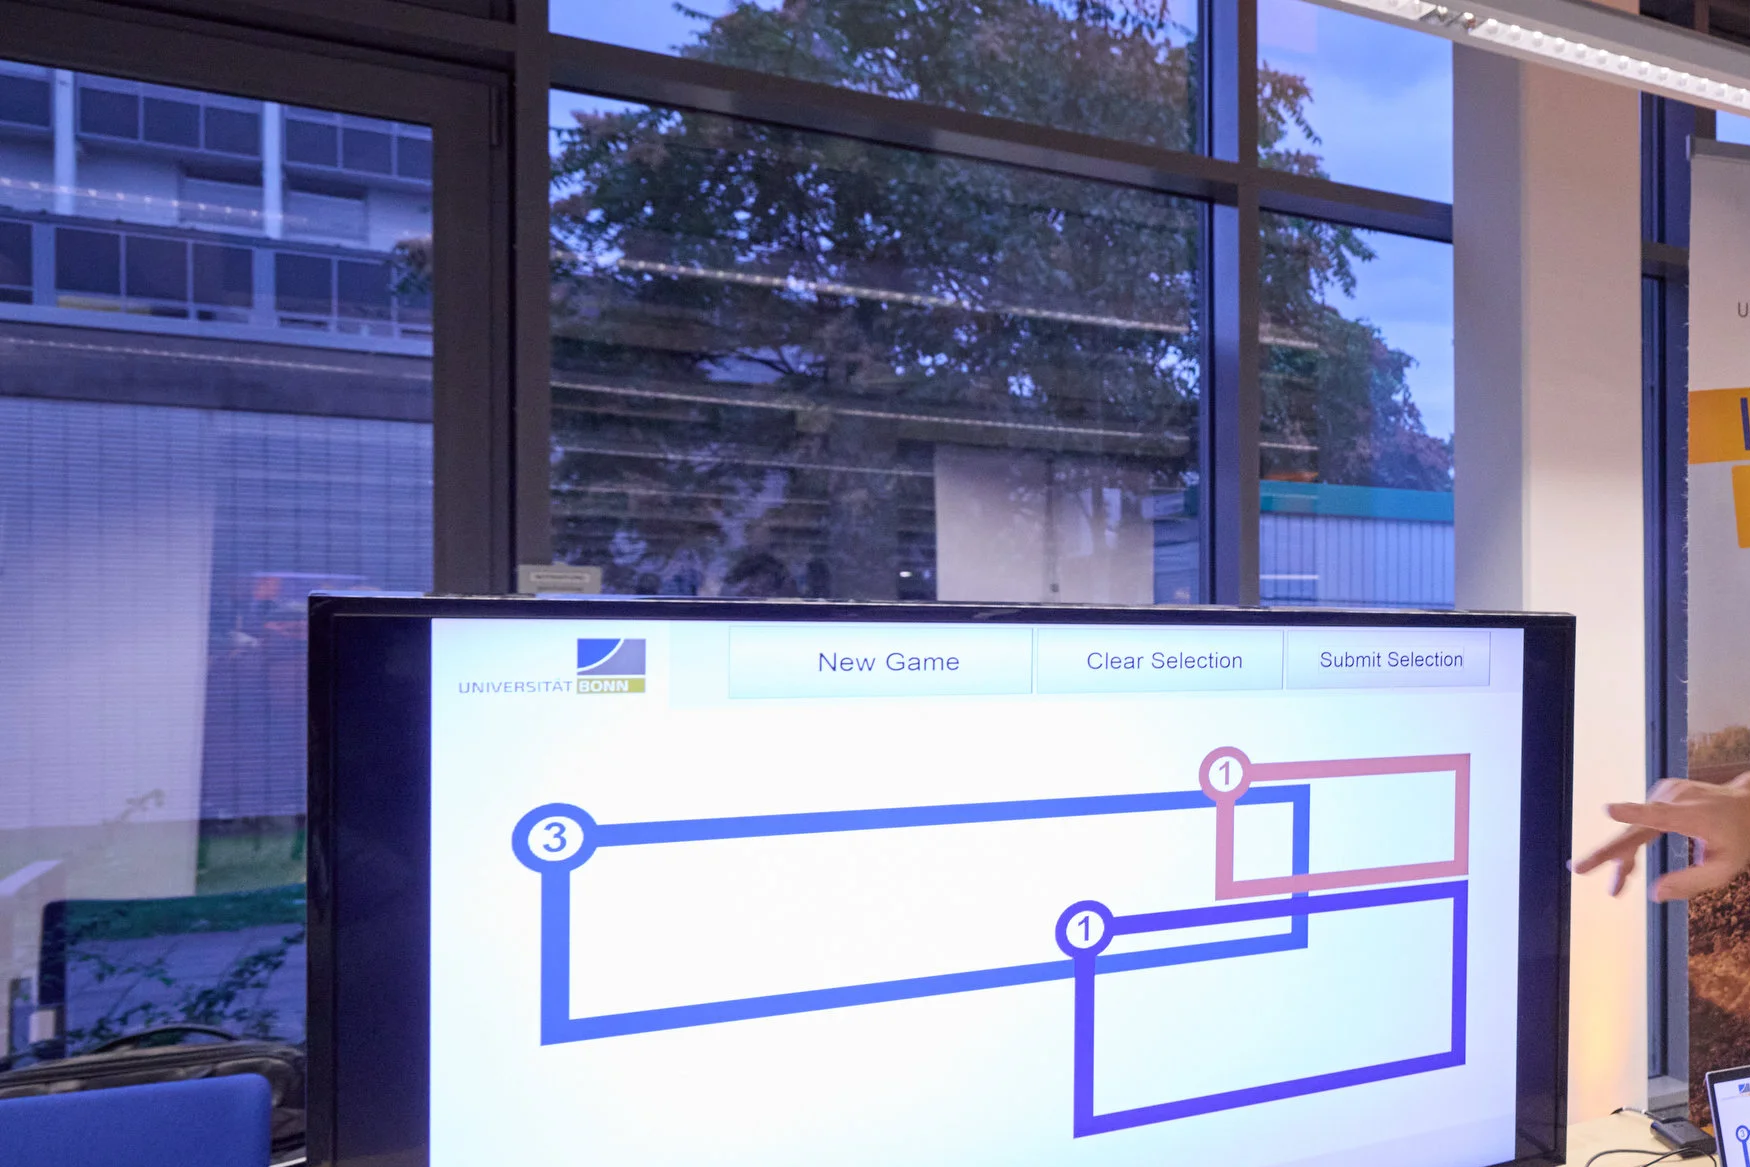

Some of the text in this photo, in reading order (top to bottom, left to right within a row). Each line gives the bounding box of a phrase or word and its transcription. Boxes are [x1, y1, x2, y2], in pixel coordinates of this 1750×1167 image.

[818, 651, 960, 672] New Game
[1086, 650, 1243, 670] Clear Selection
[1320, 650, 1464, 668] Submit Selection
[458, 679, 629, 694] UNIVERSITÄT BONN
[1218, 761, 1230, 786] 1
[543, 822, 567, 853] 3
[1077, 915, 1090, 942] 1
